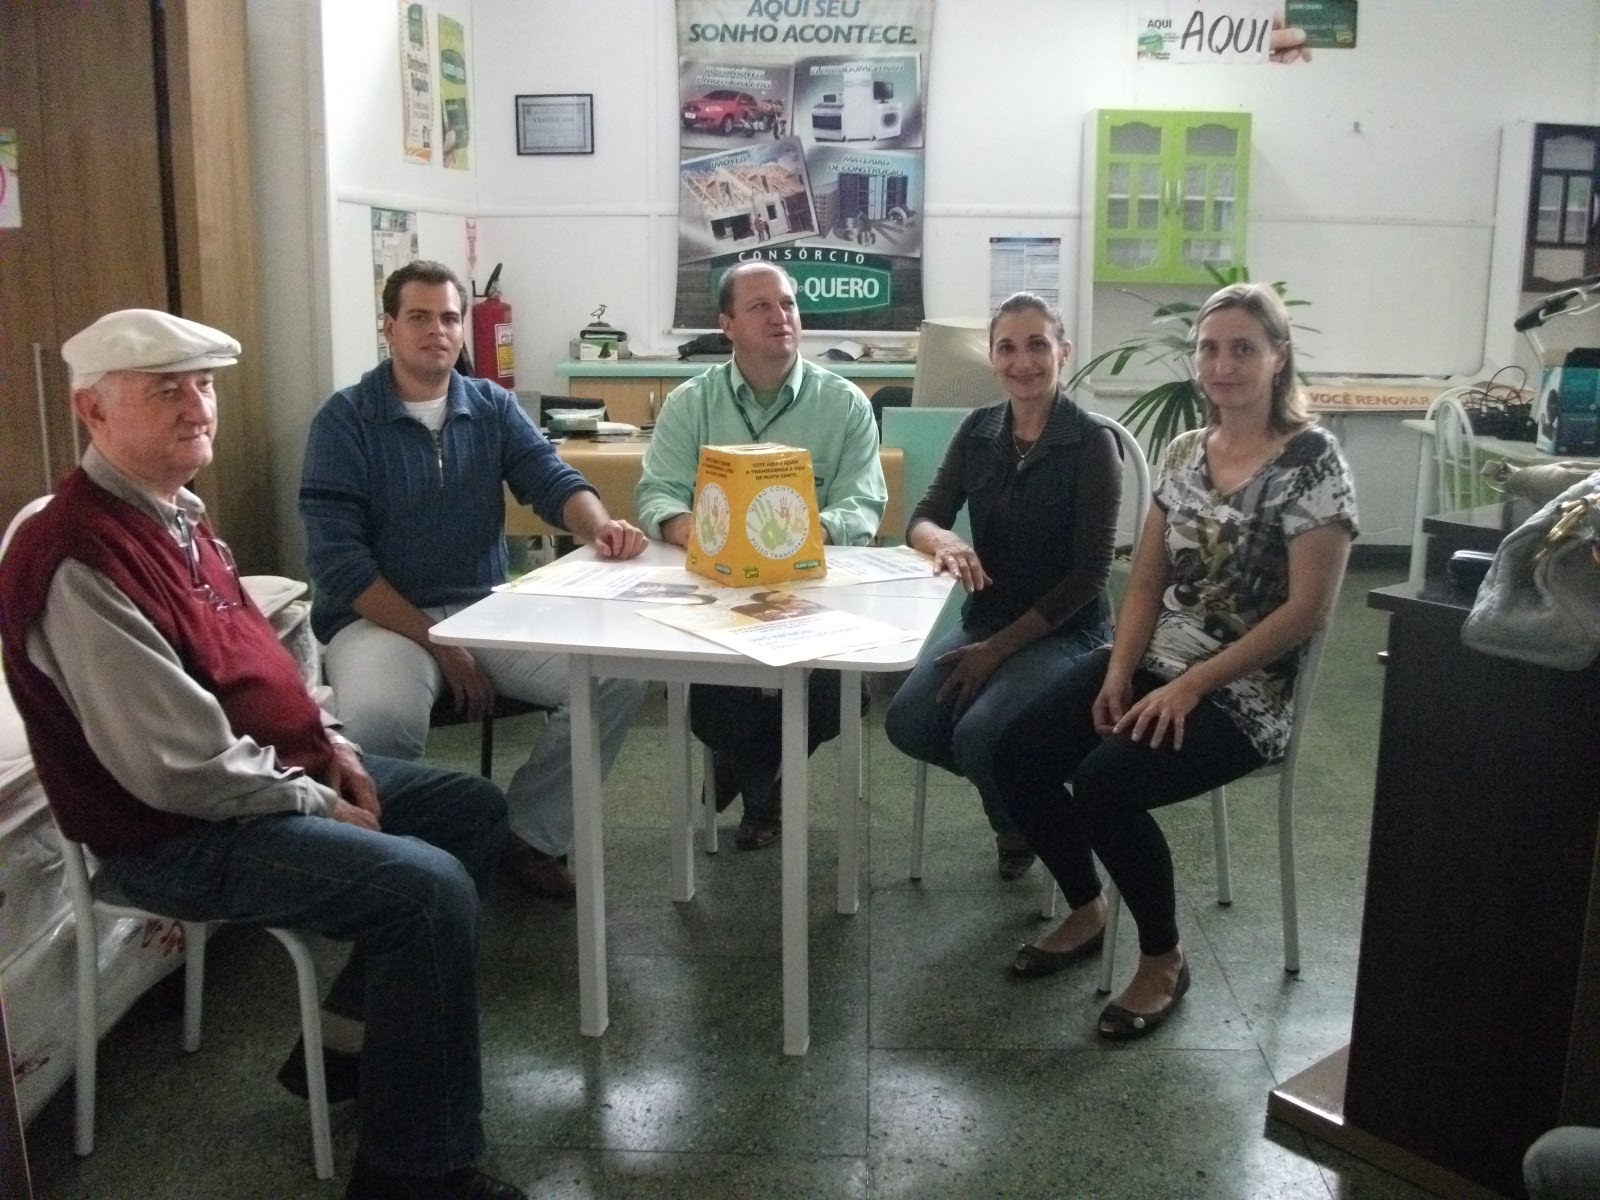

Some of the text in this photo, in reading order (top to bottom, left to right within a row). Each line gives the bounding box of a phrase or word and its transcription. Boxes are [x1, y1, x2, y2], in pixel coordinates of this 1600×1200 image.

[747, 0, 860, 22] AQUI SEU
[1147, 19, 1172, 30] AQUI
[1180, 10, 1269, 55] AQUI
[689, 24, 917, 44] SONHO ACONTECE.
[739, 248, 865, 264] CONSÓRCIO
[1309, 391, 1351, 405] VOCÊ
